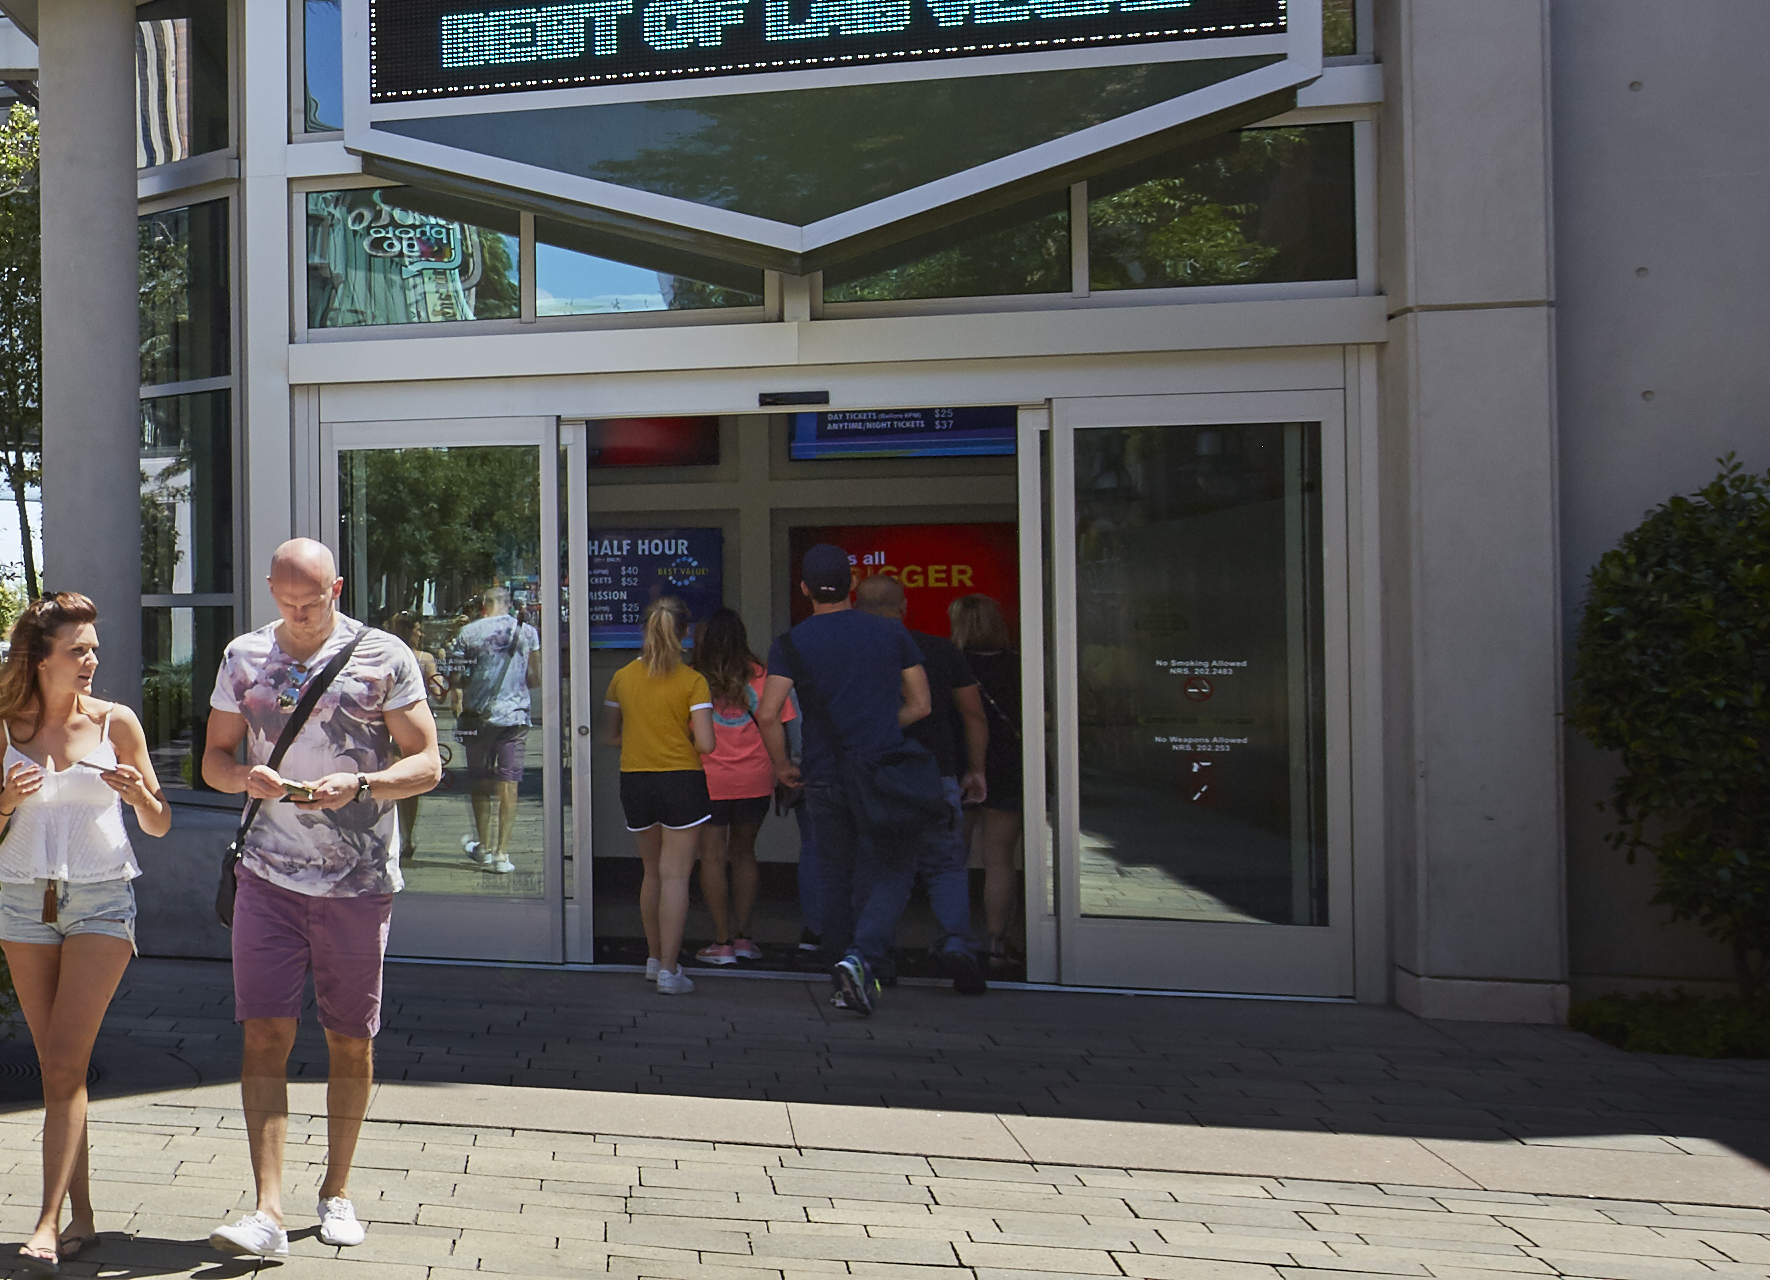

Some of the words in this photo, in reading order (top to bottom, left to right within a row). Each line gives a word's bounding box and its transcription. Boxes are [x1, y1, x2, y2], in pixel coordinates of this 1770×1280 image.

[441, 0, 633, 69] BEST
[827, 413, 843, 421] DAY
[845, 412, 877, 421] TICKETS
[934, 409, 954, 419] $25
[826, 420, 892, 431] ANYTIME/NIGHT
[893, 420, 925, 429] TICKETS
[934, 420, 954, 430] $37
[588, 539, 632, 556] HALF
[637, 539, 689, 556] HOUR
[863, 551, 886, 565] all
[620, 566, 639, 576] $40
[658, 568, 677, 576] BEST
[590, 576, 612, 585] CKETS
[620, 577, 639, 587] $52
[621, 602, 640, 612] $25
[621, 614, 640, 623] $37
[1170, 659, 1210, 668] Smoking
[1154, 736, 1168, 744] No
[1169, 736, 1210, 744] Weapons
[1211, 736, 1249, 744] Allowed
